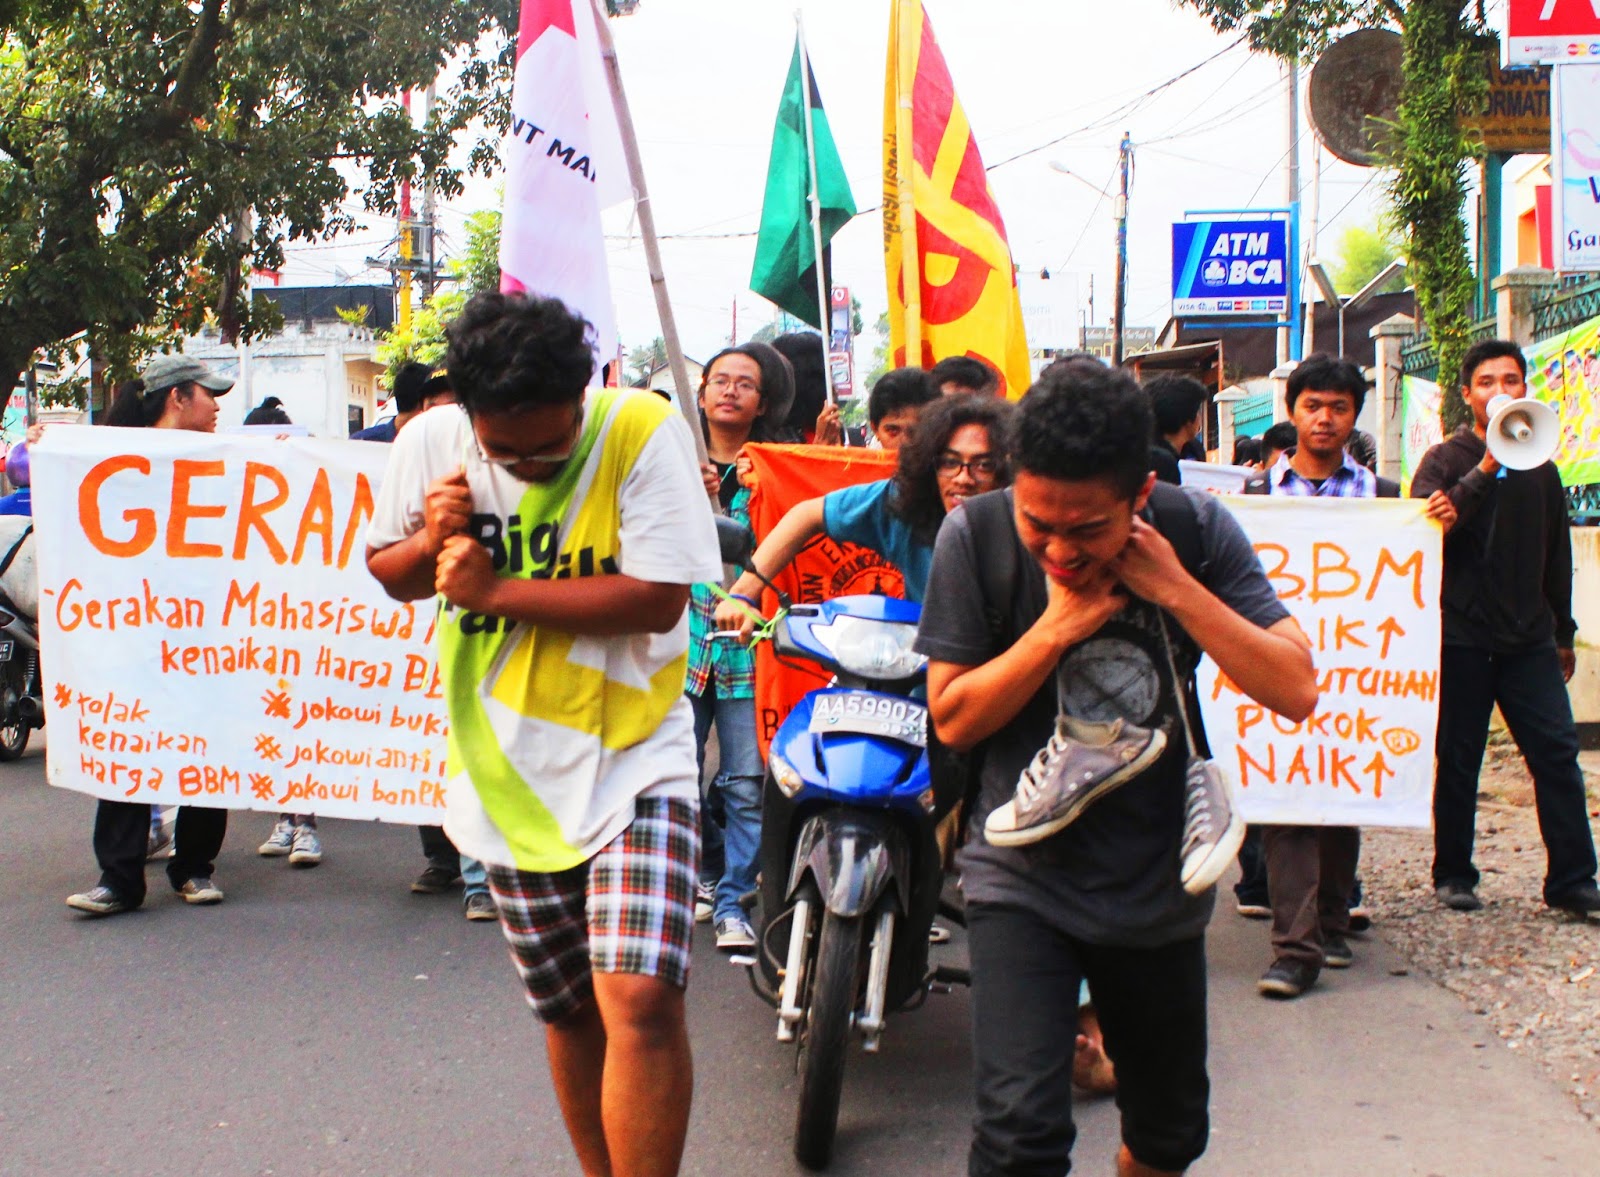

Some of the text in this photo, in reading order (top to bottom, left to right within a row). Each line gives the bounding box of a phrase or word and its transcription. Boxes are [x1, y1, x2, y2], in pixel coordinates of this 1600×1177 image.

[546, 138, 596, 183] MA
[1209, 232, 1270, 257] ATM
[1227, 258, 1283, 286] BCA
[470, 513, 560, 579] Big
[222, 579, 416, 641] Mahasiswa
[1298, 614, 1369, 652] IK
[315, 642, 393, 690] Harga
[77, 691, 150, 724] tolak
[1235, 703, 1382, 743] POKOK
[80, 753, 241, 797] Harga BBM
[375, 747, 432, 773] anti
[1235, 743, 1362, 794] NAIK
